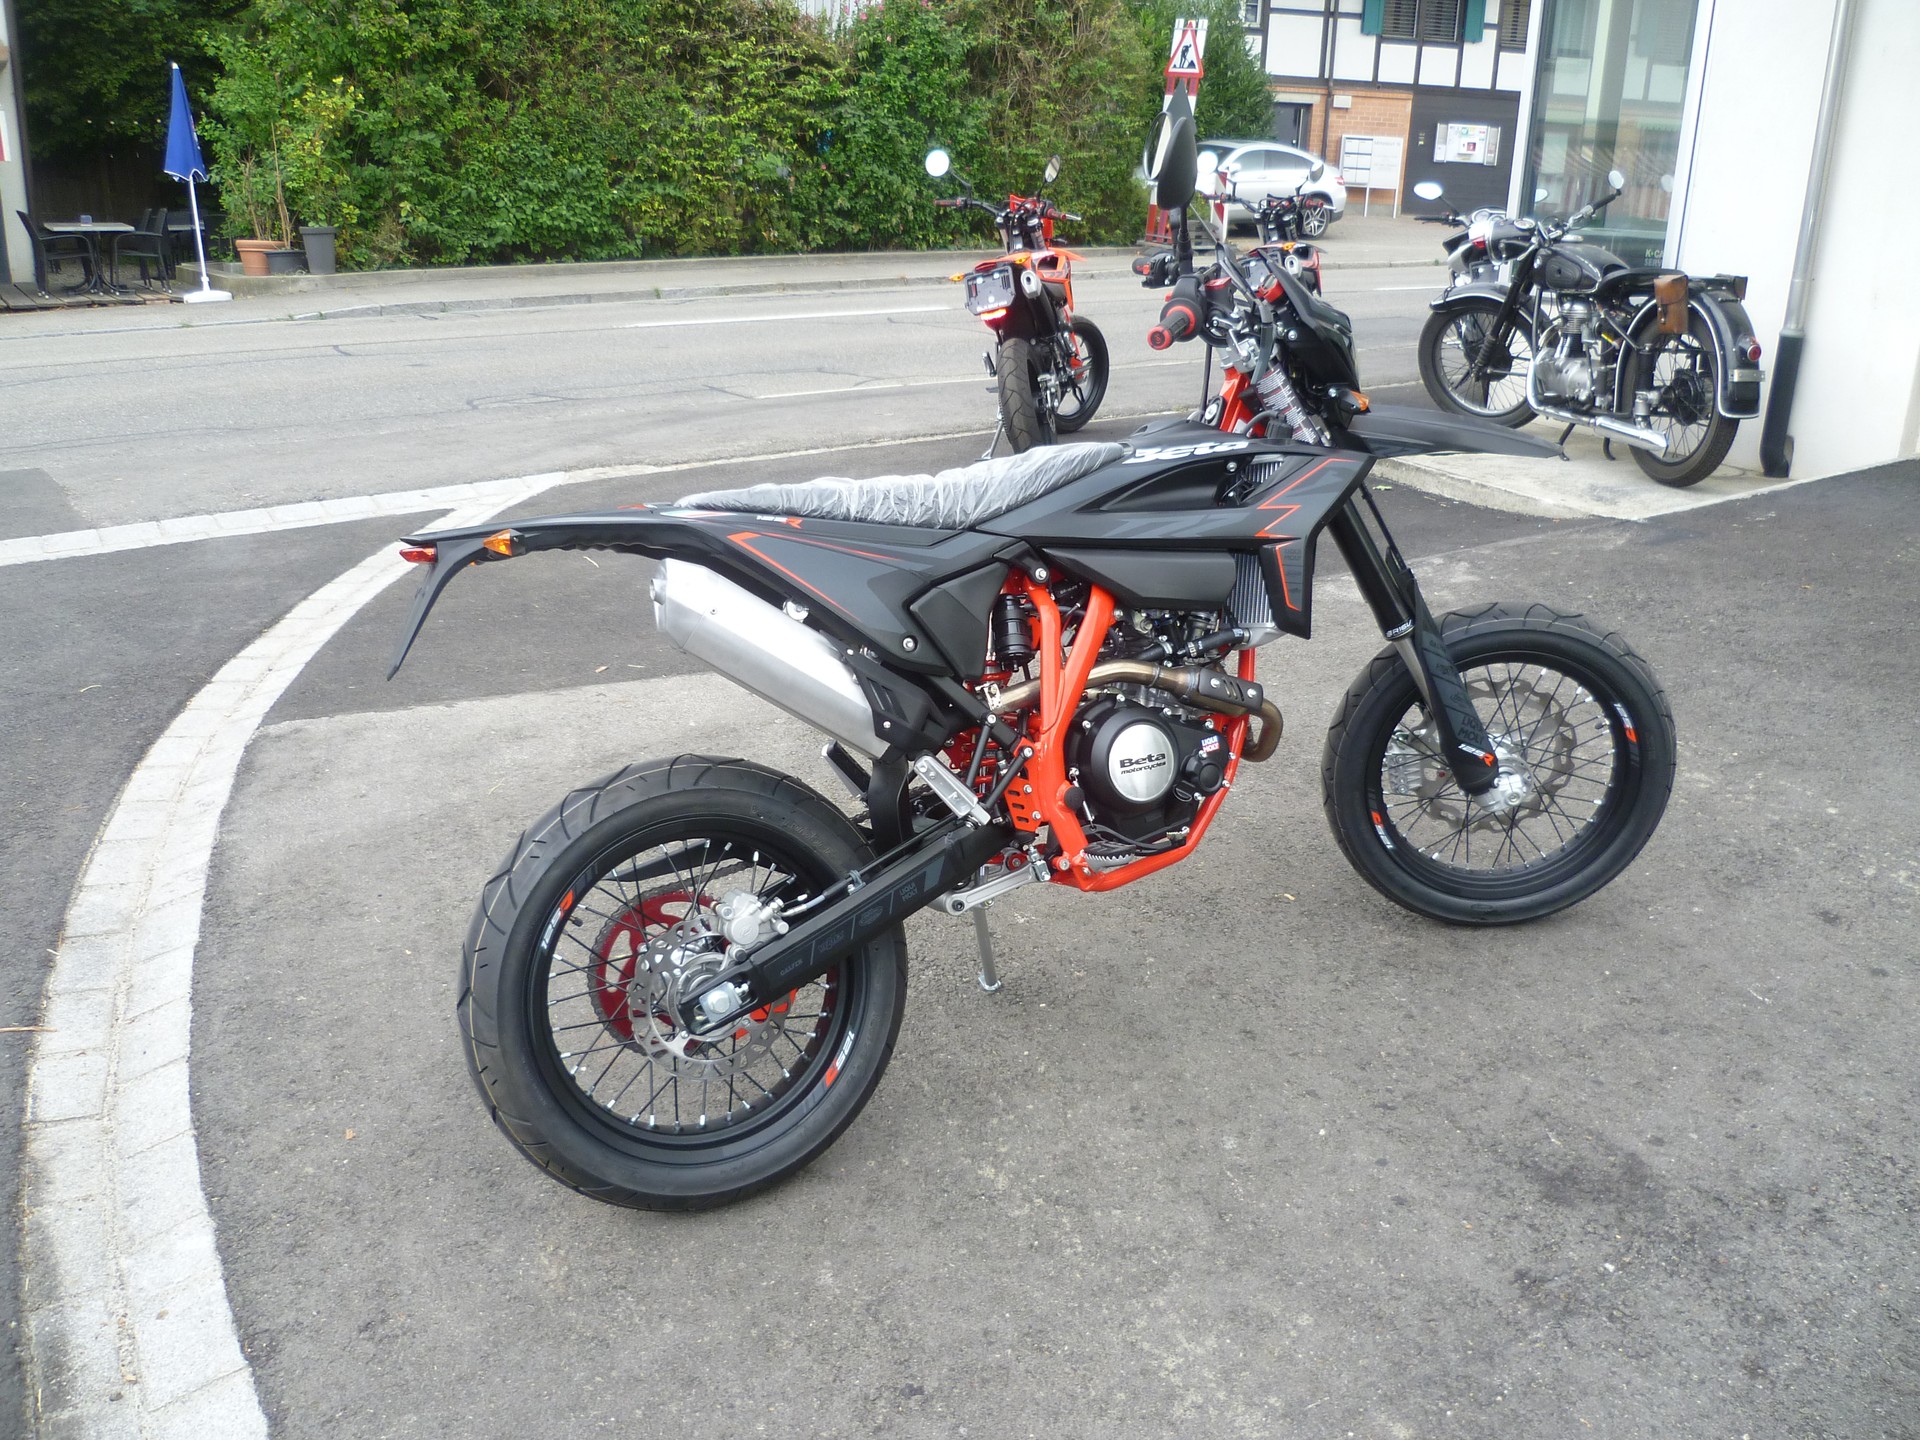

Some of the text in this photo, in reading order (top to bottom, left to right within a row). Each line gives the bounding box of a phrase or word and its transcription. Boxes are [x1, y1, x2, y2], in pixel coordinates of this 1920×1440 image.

[1201, 735, 1218, 746] LIQUI
[1202, 742, 1219, 752] MOLY
[1120, 753, 1166, 768] Beta
[1121, 761, 1166, 775] motorcycles
